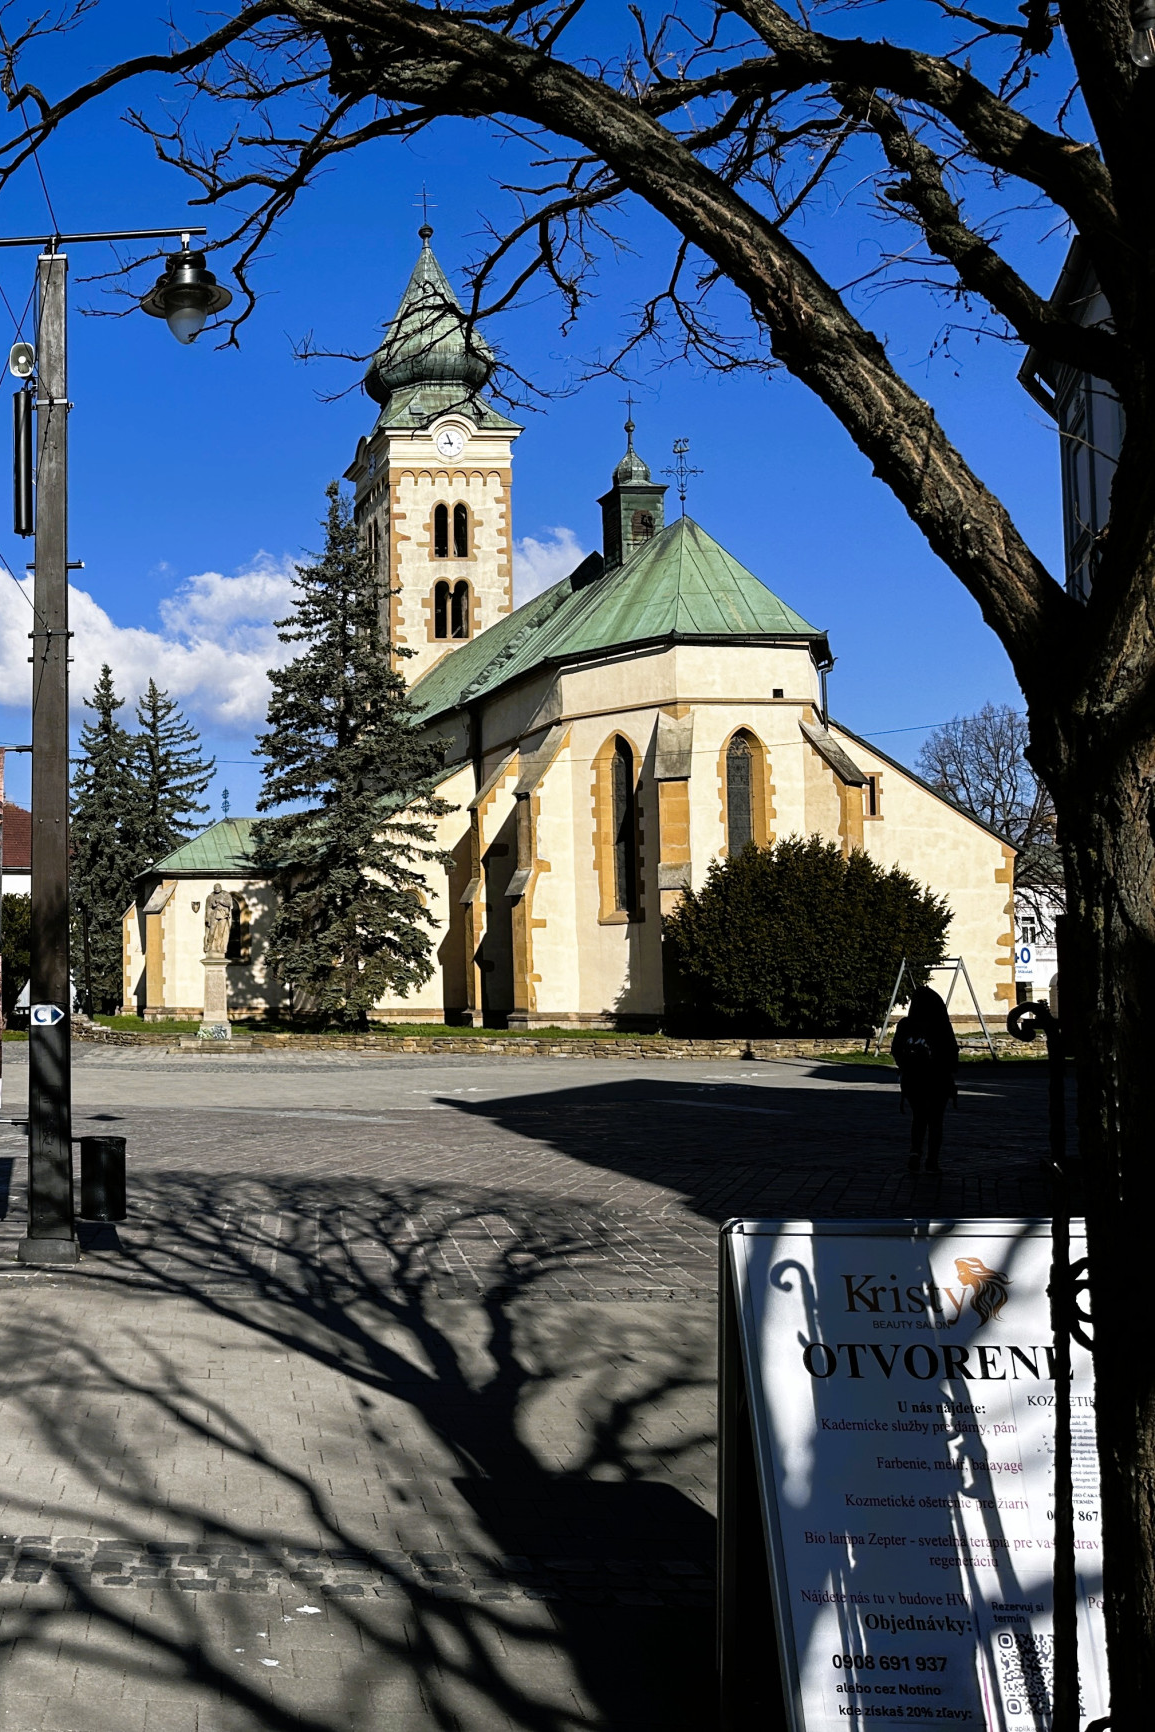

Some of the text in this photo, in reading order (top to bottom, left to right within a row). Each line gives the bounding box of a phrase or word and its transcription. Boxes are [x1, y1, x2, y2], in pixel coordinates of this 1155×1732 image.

[840, 1274, 967, 1326] Kristy
[873, 1320, 951, 1330] BEAUTY SALON
[898, 1401, 986, 1416] U nás nájdete:
[1027, 1395, 1095, 1407] KOZETIK
[892, 1419, 929, 1435] služby
[932, 1423, 950, 1435] pre
[955, 1421, 991, 1436] dámy,
[994, 1421, 1017, 1436] pán
[877, 1456, 931, 1472] Farbenie,
[971, 1459, 1023, 1475] balayage
[845, 1493, 915, 1508] Kozmetické
[918, 1495, 972, 1509] ošetrenie
[975, 1500, 994, 1511] pre
[1078, 1511, 1099, 1521] 867
[804, 1531, 826, 1544] Bio
[829, 1532, 865, 1548] lampa
[868, 1532, 907, 1549] Zepter
[918, 1533, 967, 1547] svetelná
[969, 1536, 1009, 1551] terapia
[1013, 1538, 1033, 1551] pre
[929, 1555, 999, 1569] regeneráciu
[801, 1589, 846, 1604] Nájdete
[850, 1591, 870, 1604] nás
[871, 1593, 885, 1604] tu
[888, 1596, 896, 1604] v
[899, 1592, 943, 1605] budove
[991, 1602, 1044, 1613] Rezervuj si
[865, 1613, 972, 1633] Objednávky:
[994, 1613, 1025, 1623] termín
[832, 1654, 947, 1672] 0908 691 937
[836, 1683, 941, 1696] alebo cez Notino
[838, 1705, 972, 1720] kde získaš 20% zľavy:
